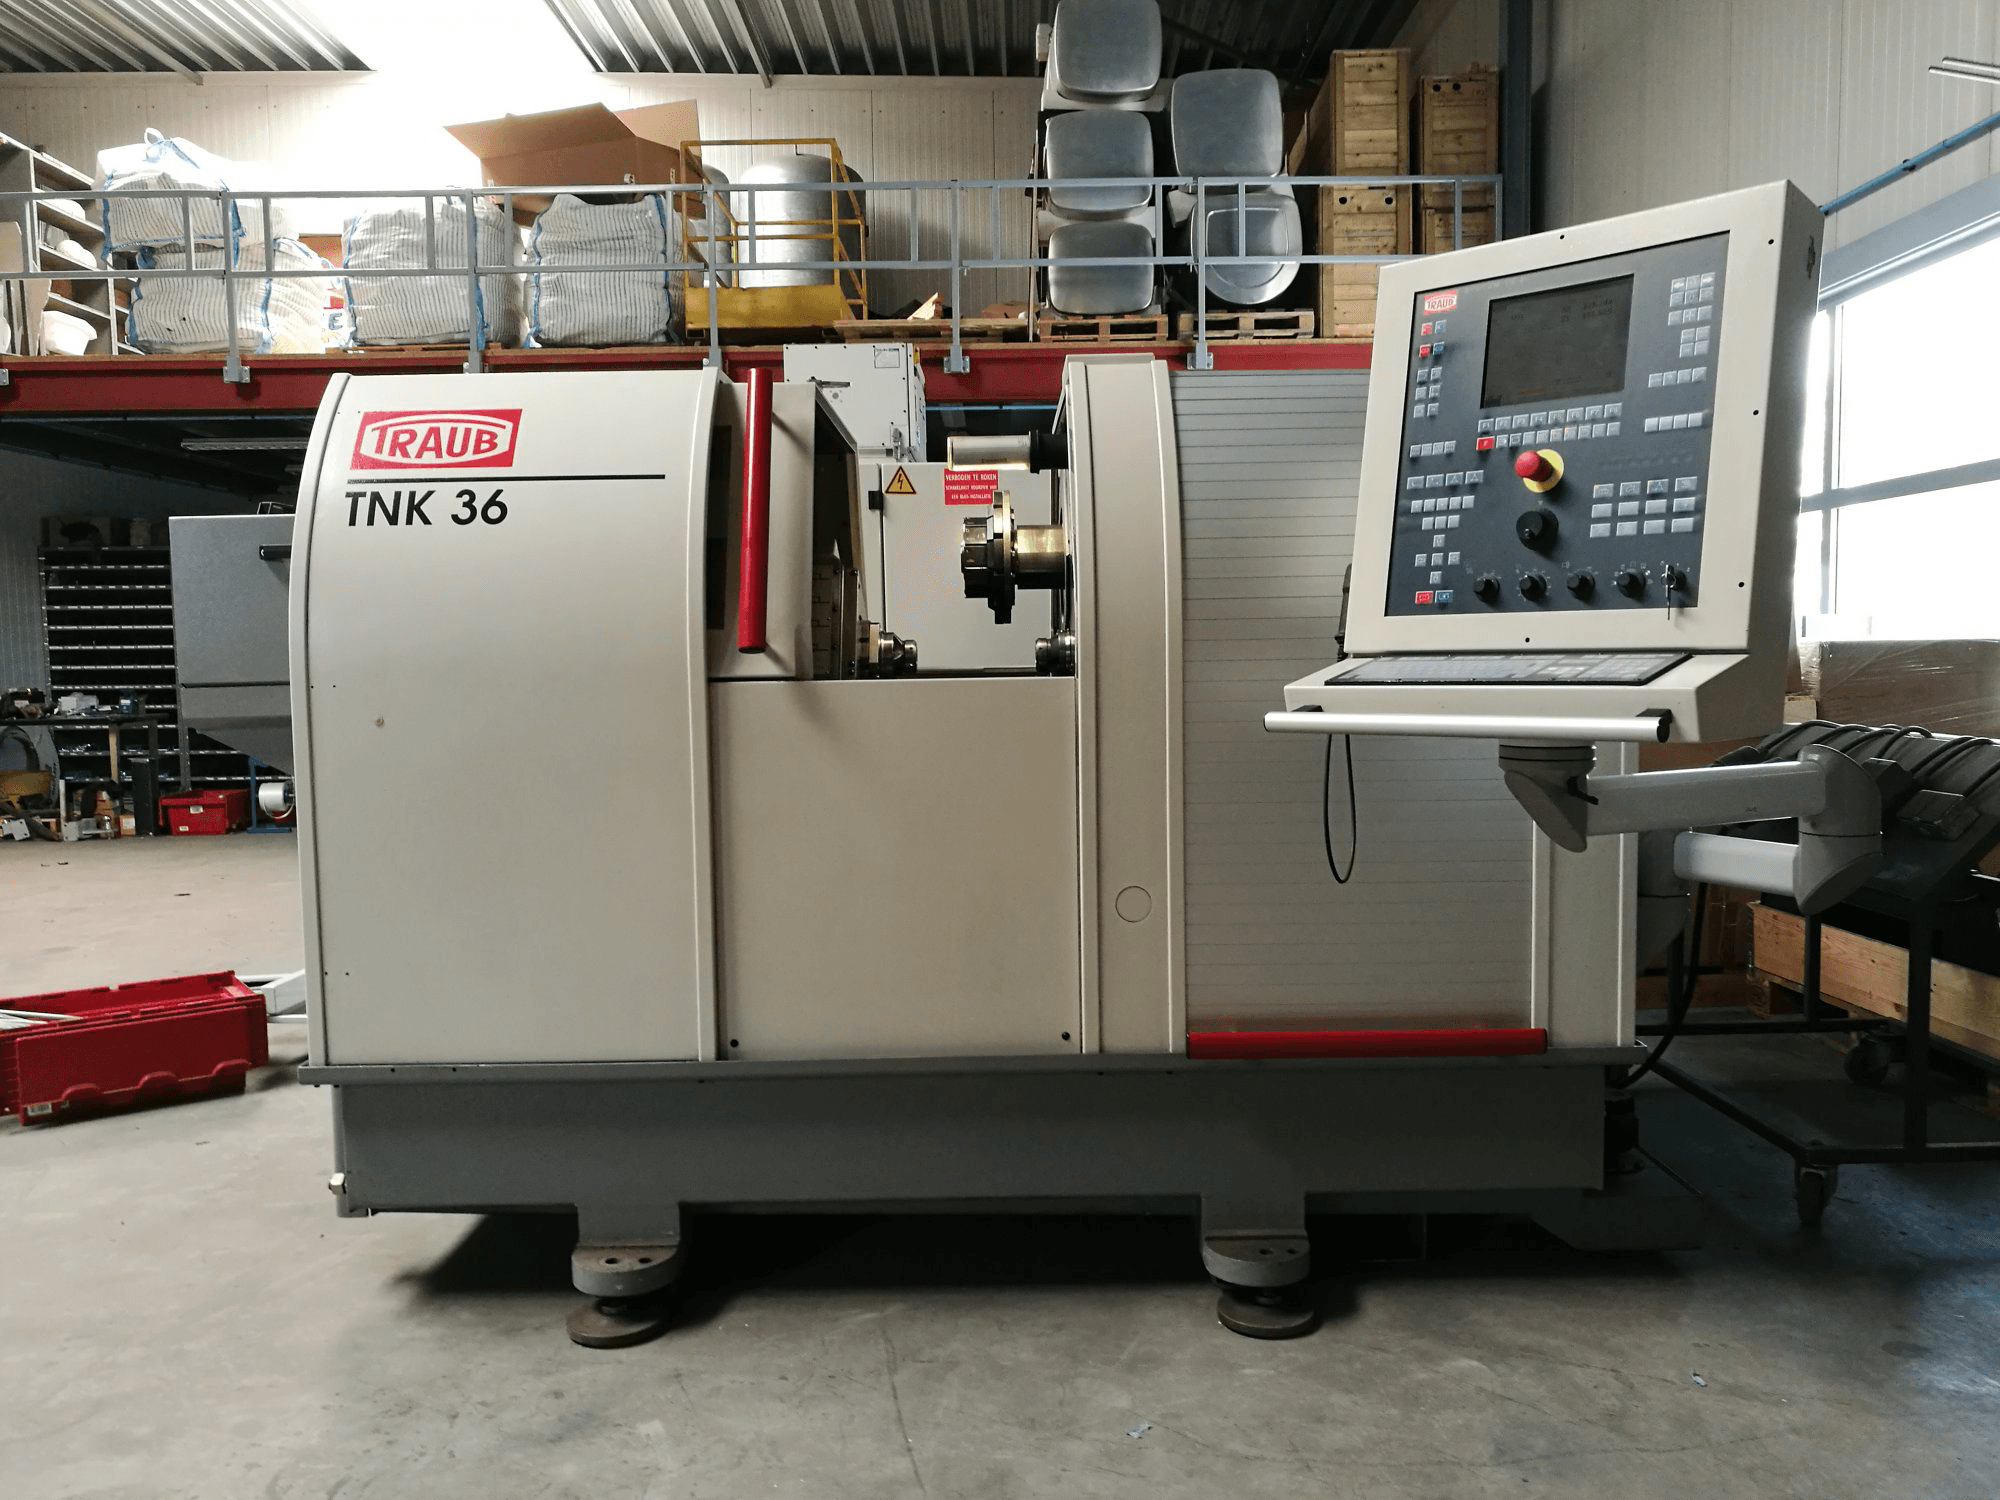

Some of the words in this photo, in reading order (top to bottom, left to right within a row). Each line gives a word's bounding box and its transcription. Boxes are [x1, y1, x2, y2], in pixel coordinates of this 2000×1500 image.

[1427, 296, 1455, 310] TRAUB
[371, 419, 505, 459] TRAUB
[345, 490, 436, 526] TNK
[451, 489, 508, 526] 36
